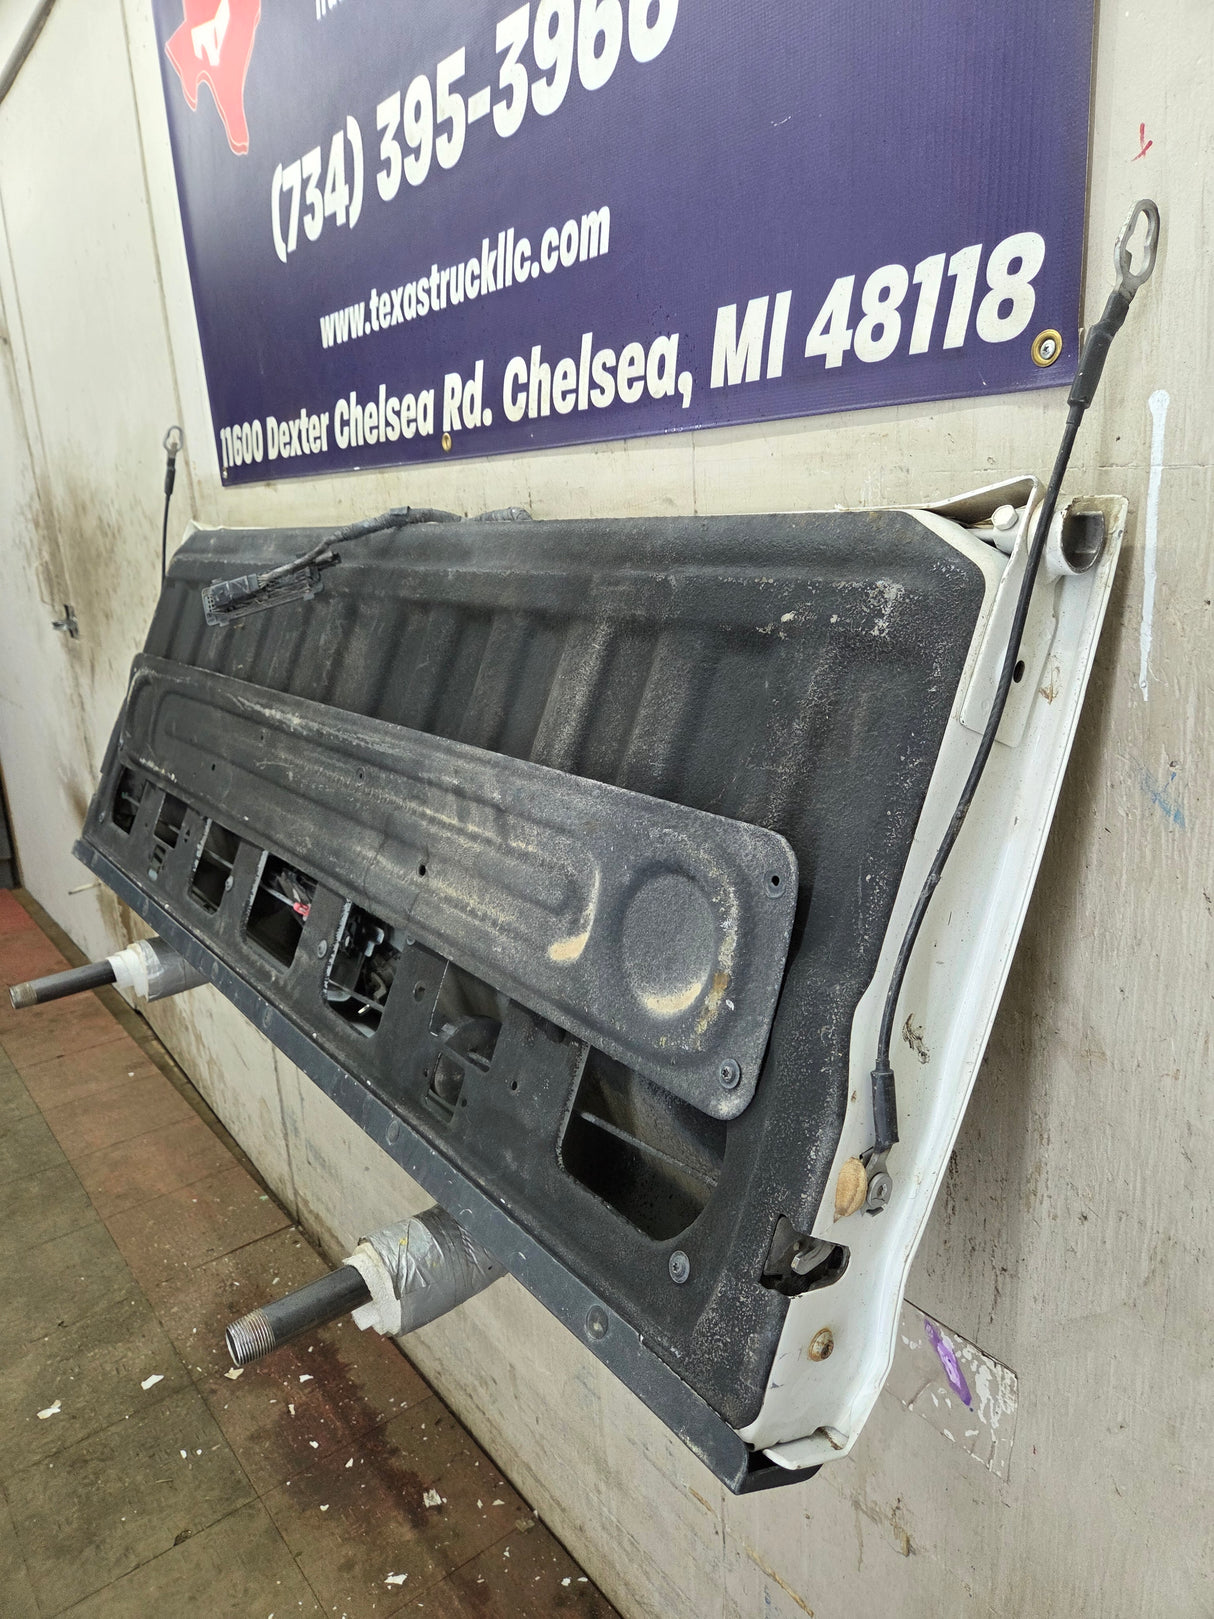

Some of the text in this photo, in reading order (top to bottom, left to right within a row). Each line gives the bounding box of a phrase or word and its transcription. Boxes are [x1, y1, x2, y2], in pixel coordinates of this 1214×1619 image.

[270, 115, 364, 263] (734)
[220, 231, 1046, 468] 11600 Dexter Chelsea Rd. Chelsea, MI 48118
[319, 205, 611, 349] www.texastruckllc.com
